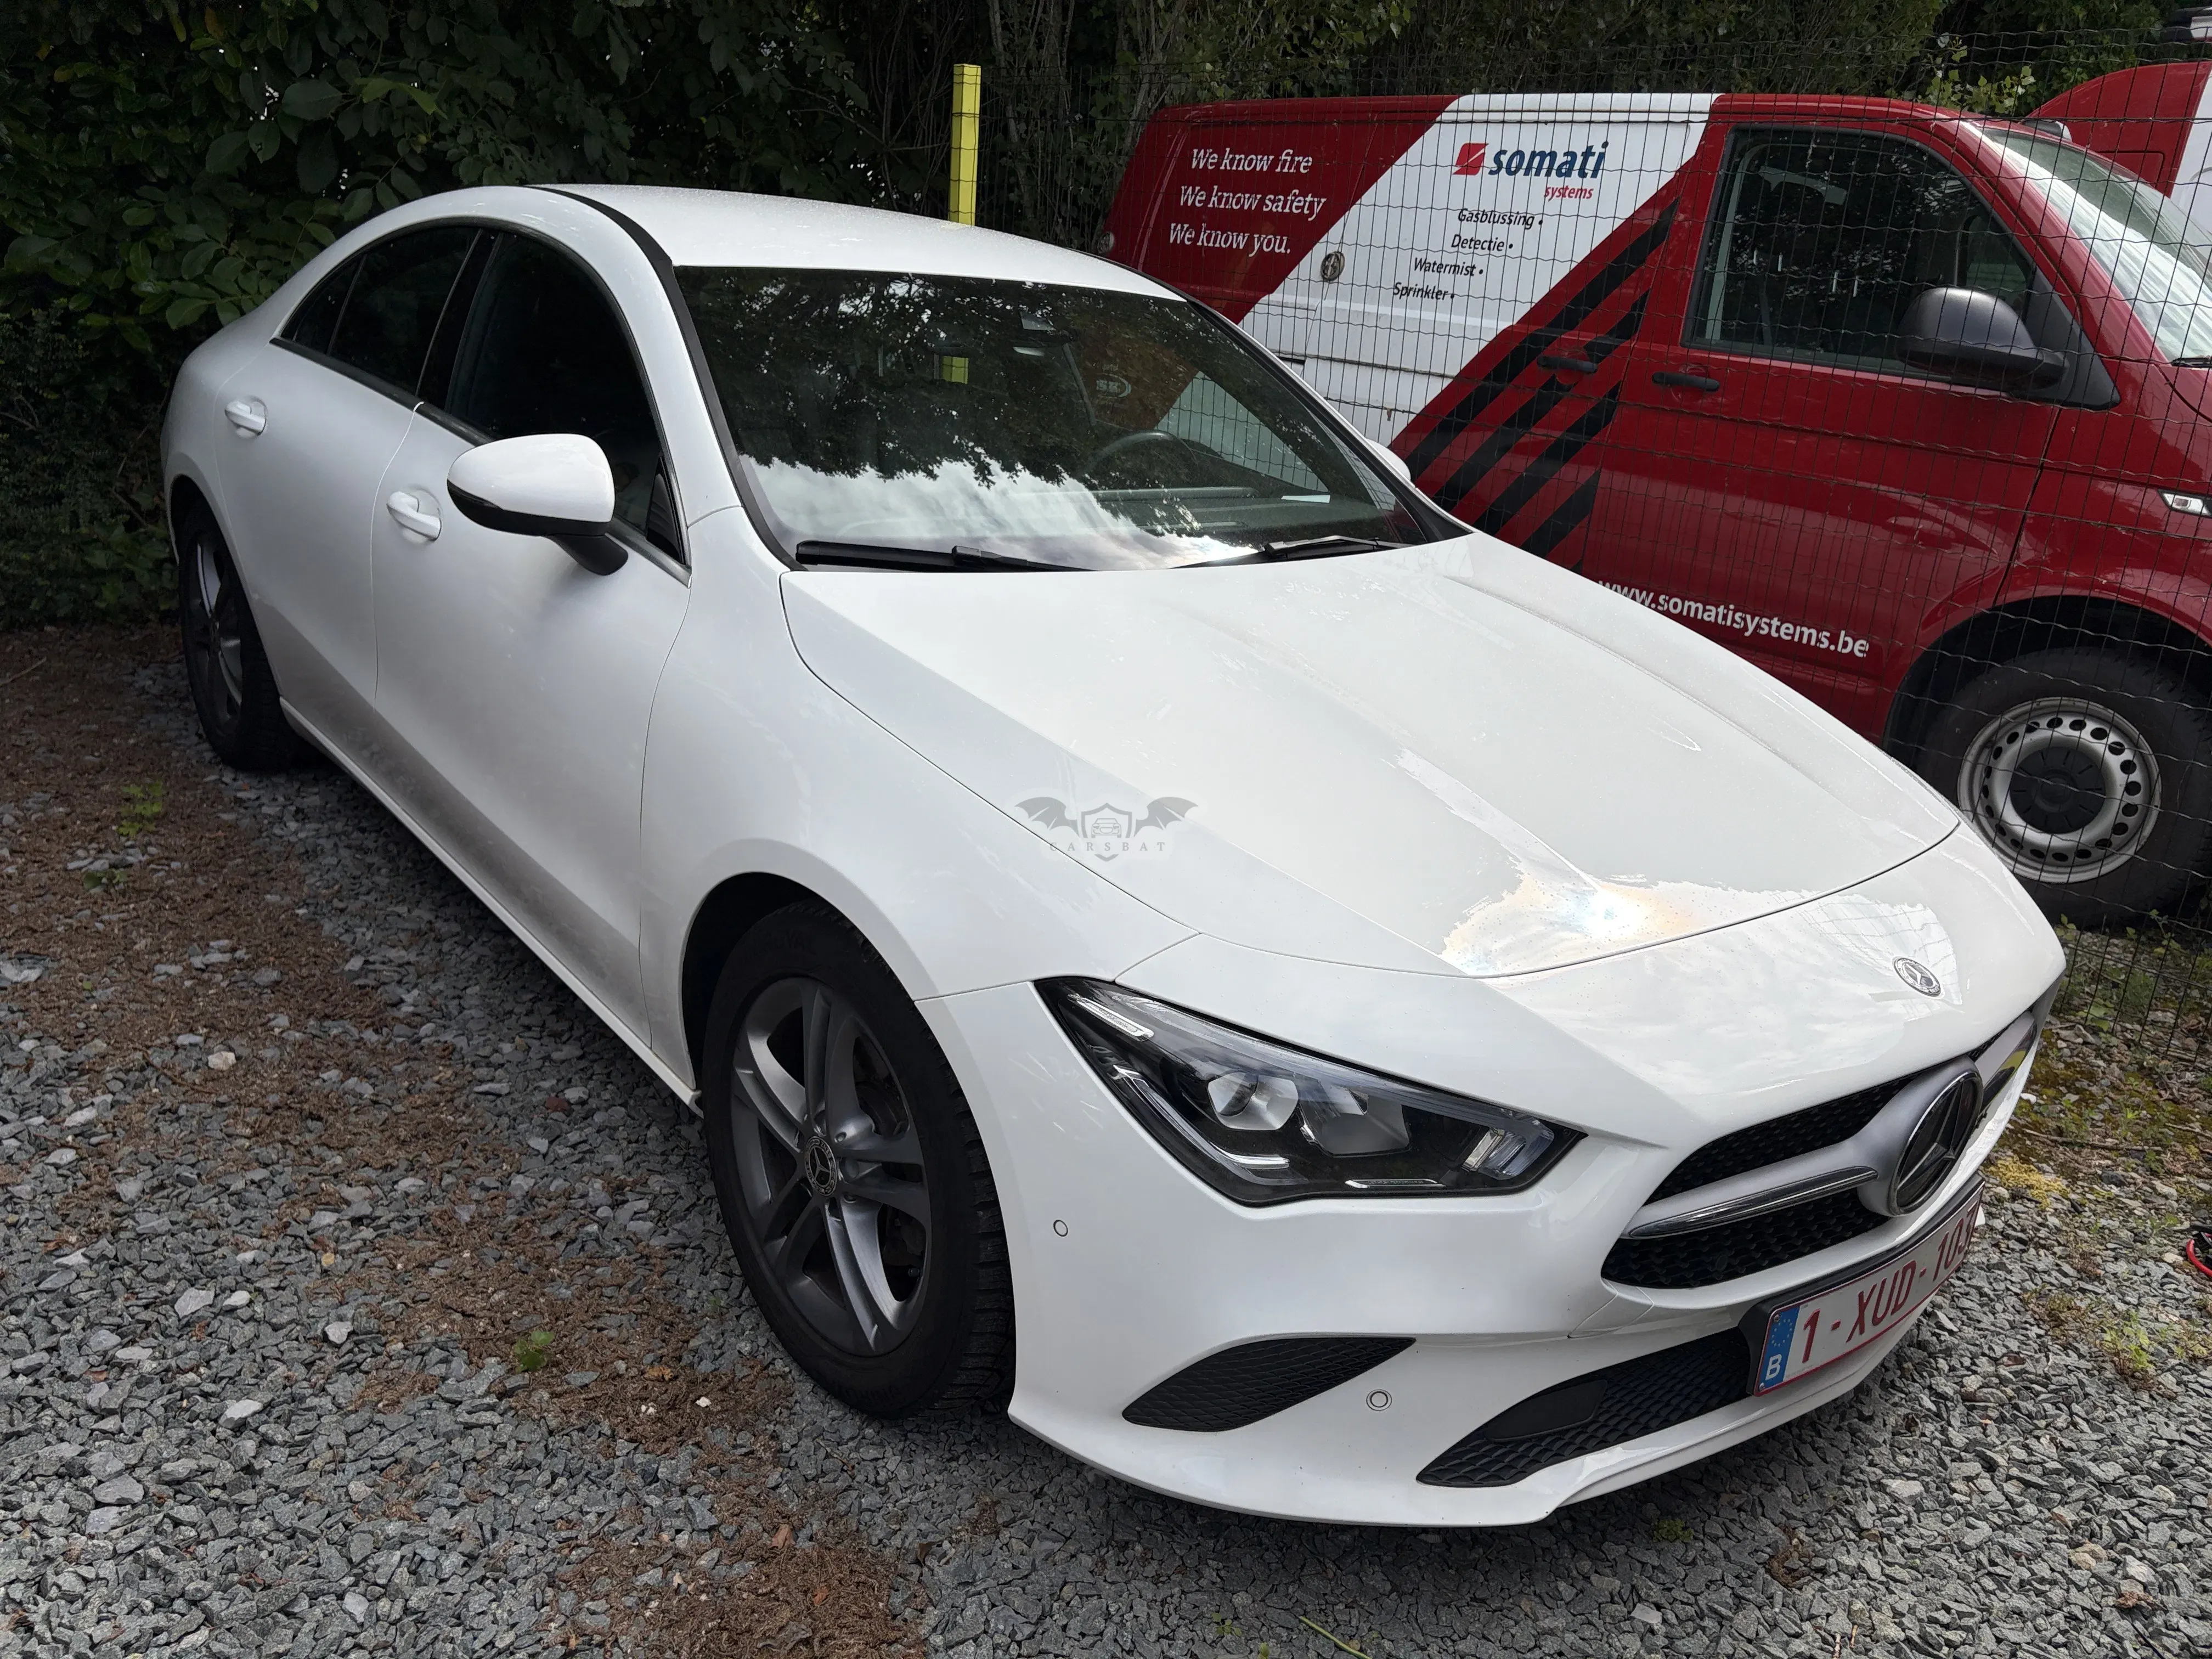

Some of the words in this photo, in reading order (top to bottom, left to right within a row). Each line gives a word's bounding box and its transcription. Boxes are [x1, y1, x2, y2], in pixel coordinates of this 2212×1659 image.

[1192, 148, 1219, 170] We
[1220, 148, 1274, 173] know
[1275, 149, 1313, 173] fire
[1488, 141, 1609, 179] somati
[1180, 185, 1206, 207] We
[1208, 185, 1262, 211] know
[1263, 189, 1327, 221] safety
[1544, 184, 1594, 202] systems
[1458, 208, 1536, 230] Gasblussing
[1170, 223, 1195, 245] We
[1197, 223, 1250, 249] know
[1249, 234, 1291, 257] you.
[1451, 234, 1504, 251] Detectie
[1414, 258, 1476, 276] Watermist
[1393, 282, 1448, 301] Sprinkler
[1764, 1353, 1782, 1381] B
